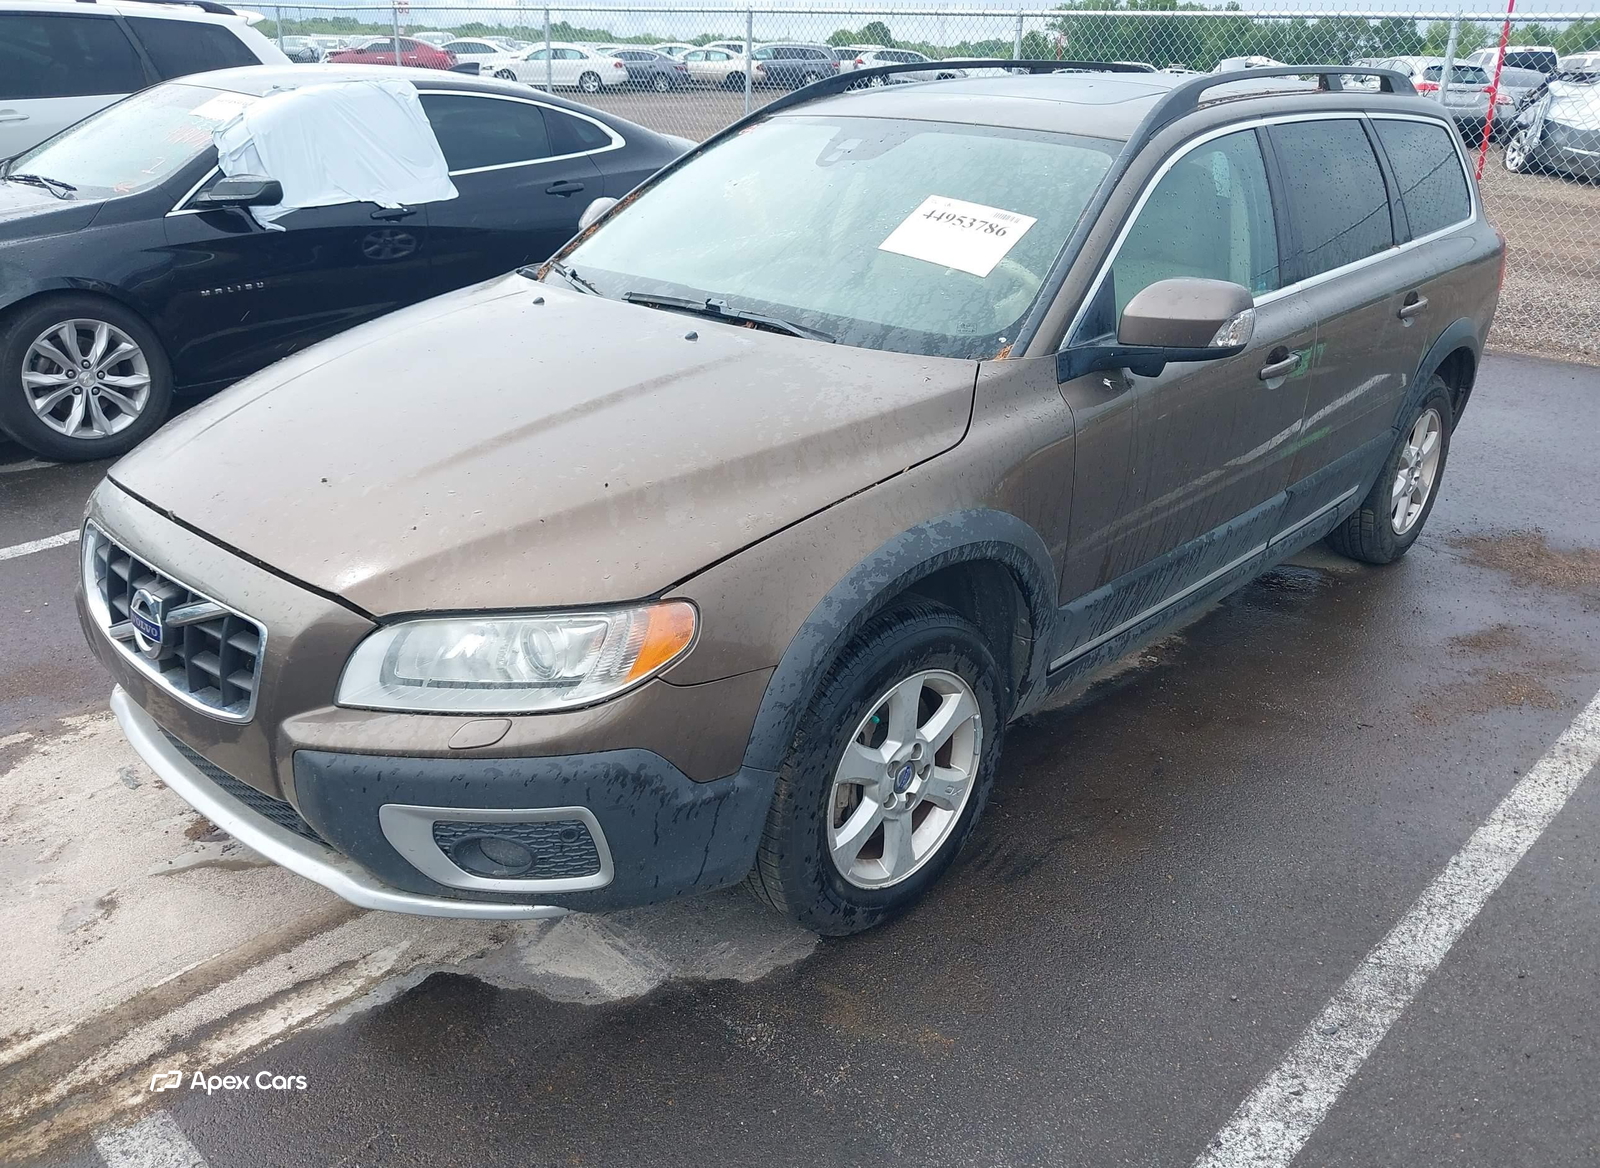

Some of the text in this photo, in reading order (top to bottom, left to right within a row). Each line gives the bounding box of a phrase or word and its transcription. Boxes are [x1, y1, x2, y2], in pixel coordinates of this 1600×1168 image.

[922, 208, 1008, 238] 44953786
[200, 281, 264, 297] MALIBU
[131, 613, 158, 638] VOLVO
